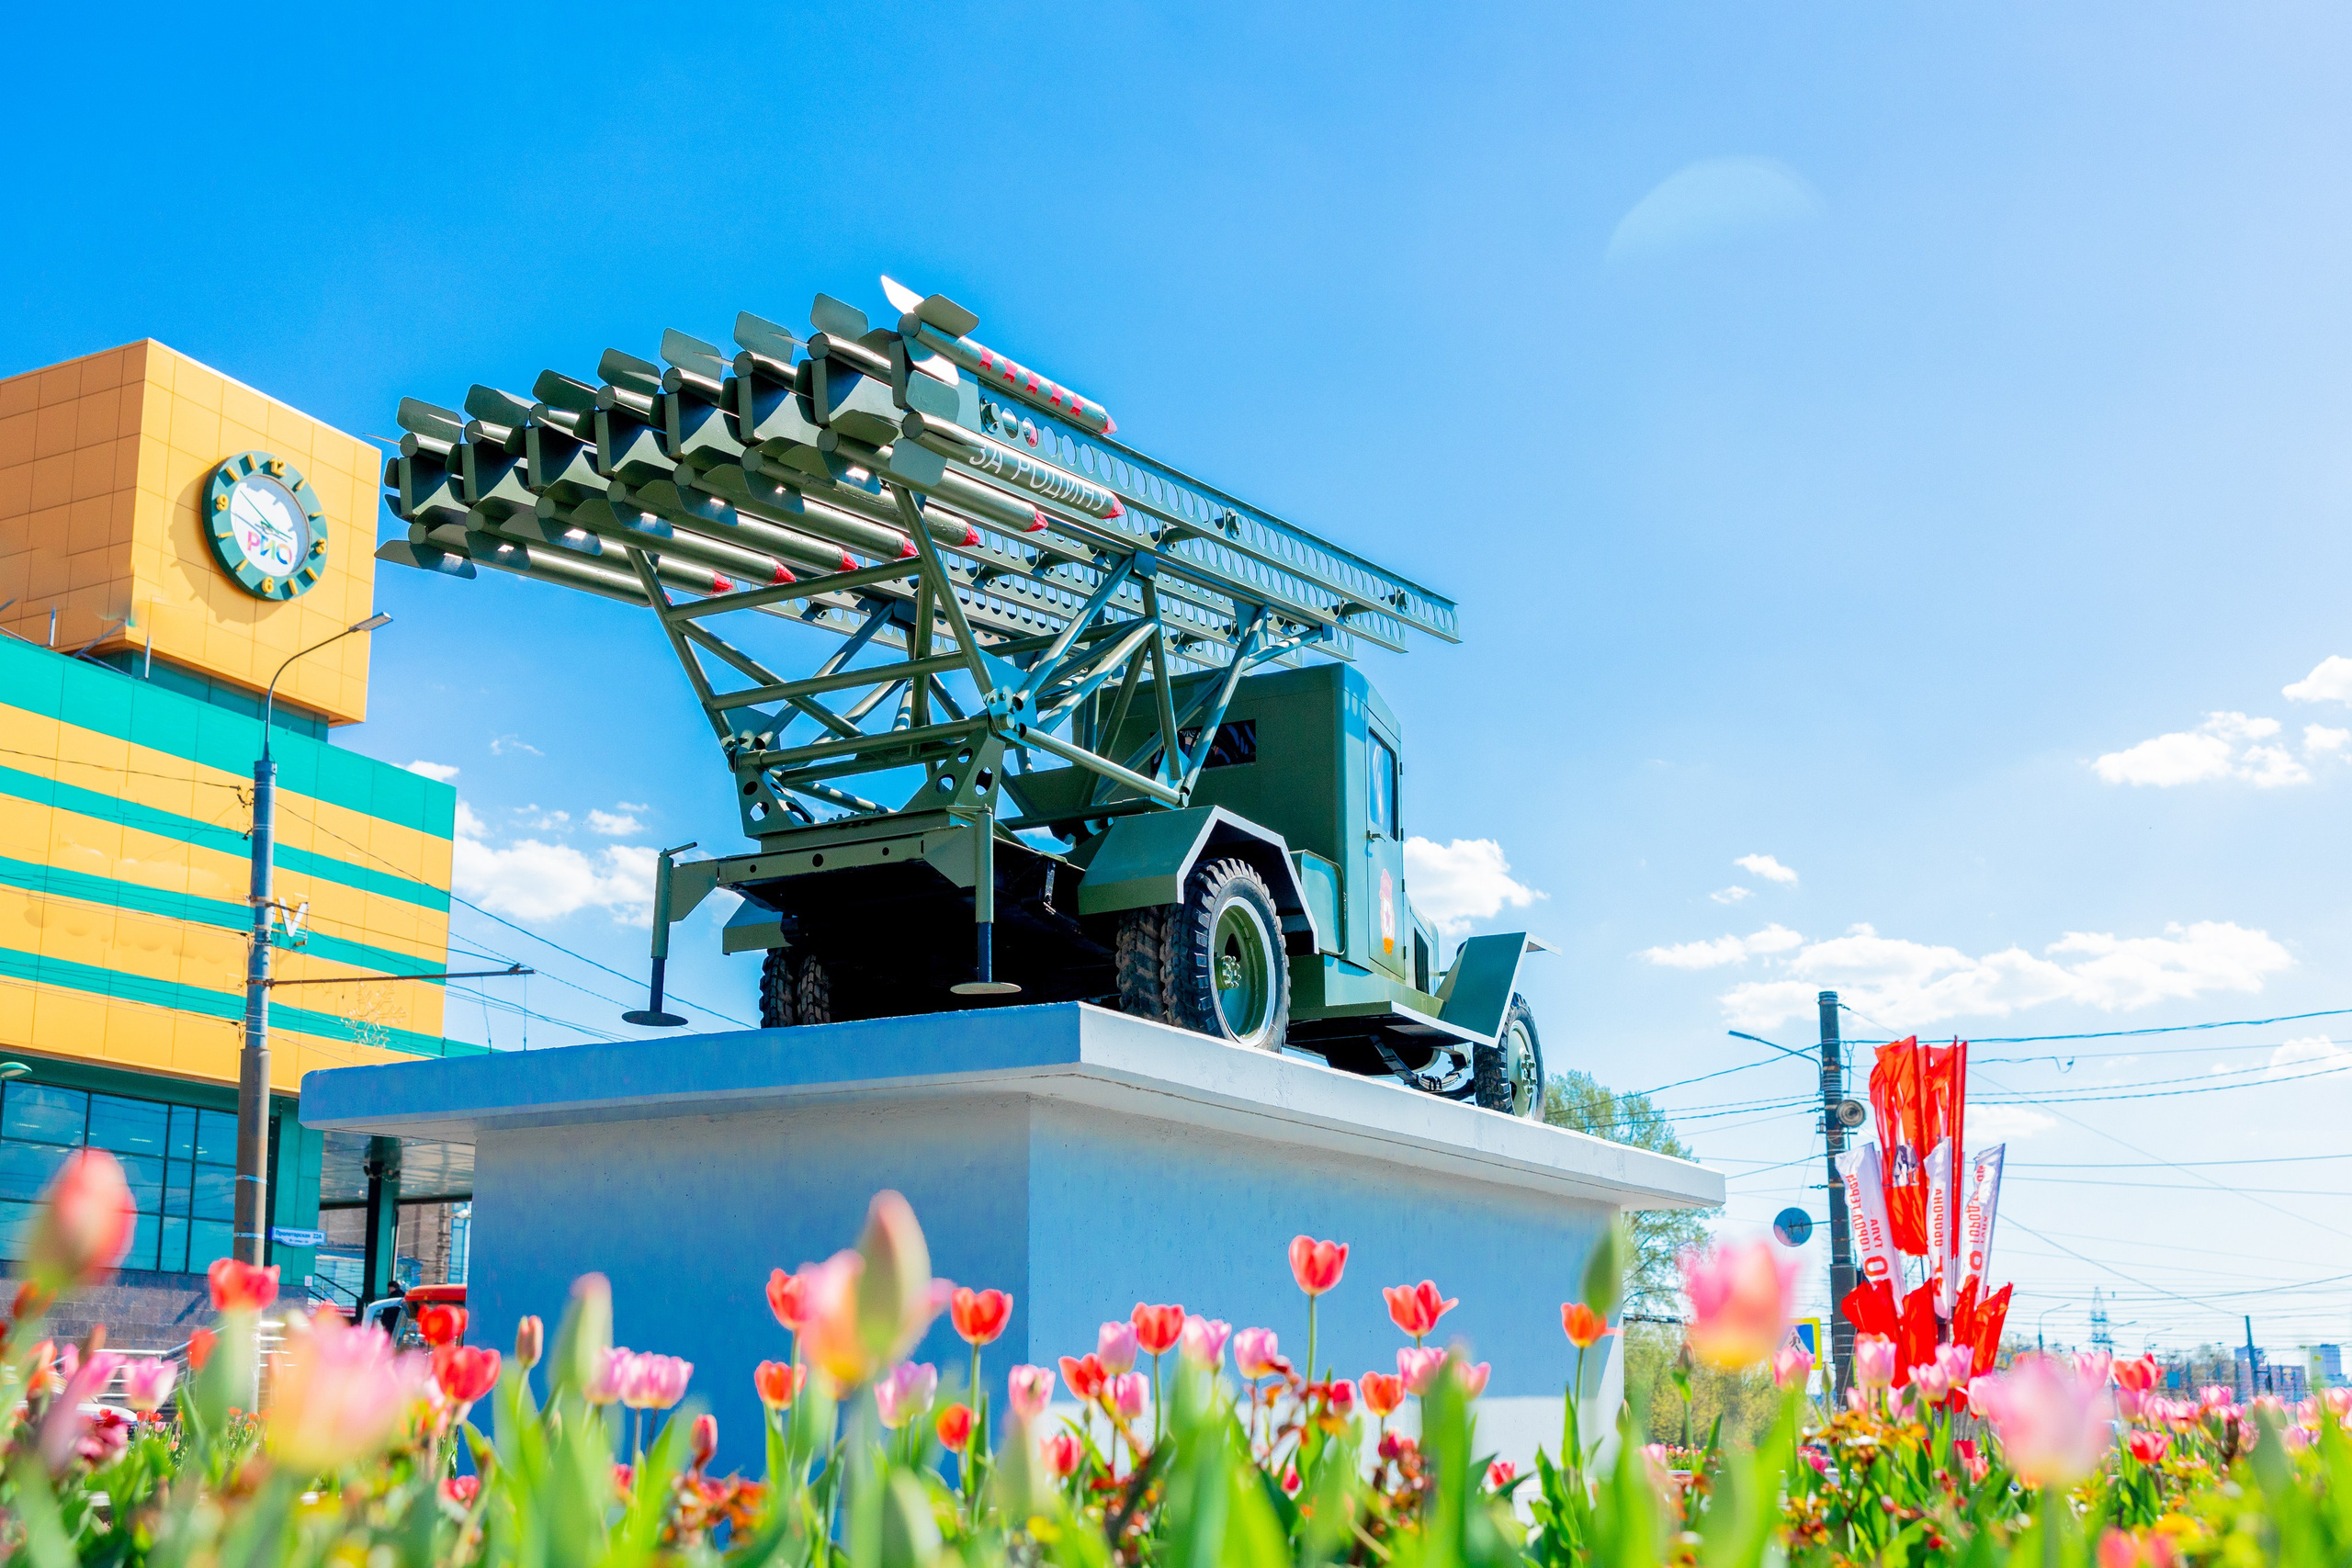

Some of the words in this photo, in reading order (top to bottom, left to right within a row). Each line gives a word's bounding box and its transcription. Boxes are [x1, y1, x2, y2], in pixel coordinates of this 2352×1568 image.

[269, 457, 288, 477] 12
[968, 443, 1003, 474] ЗА
[1011, 457, 1106, 512] РОДИНУ
[216, 493, 229, 511] 9
[315, 538, 327, 555] 3
[262, 576, 274, 593] 6
